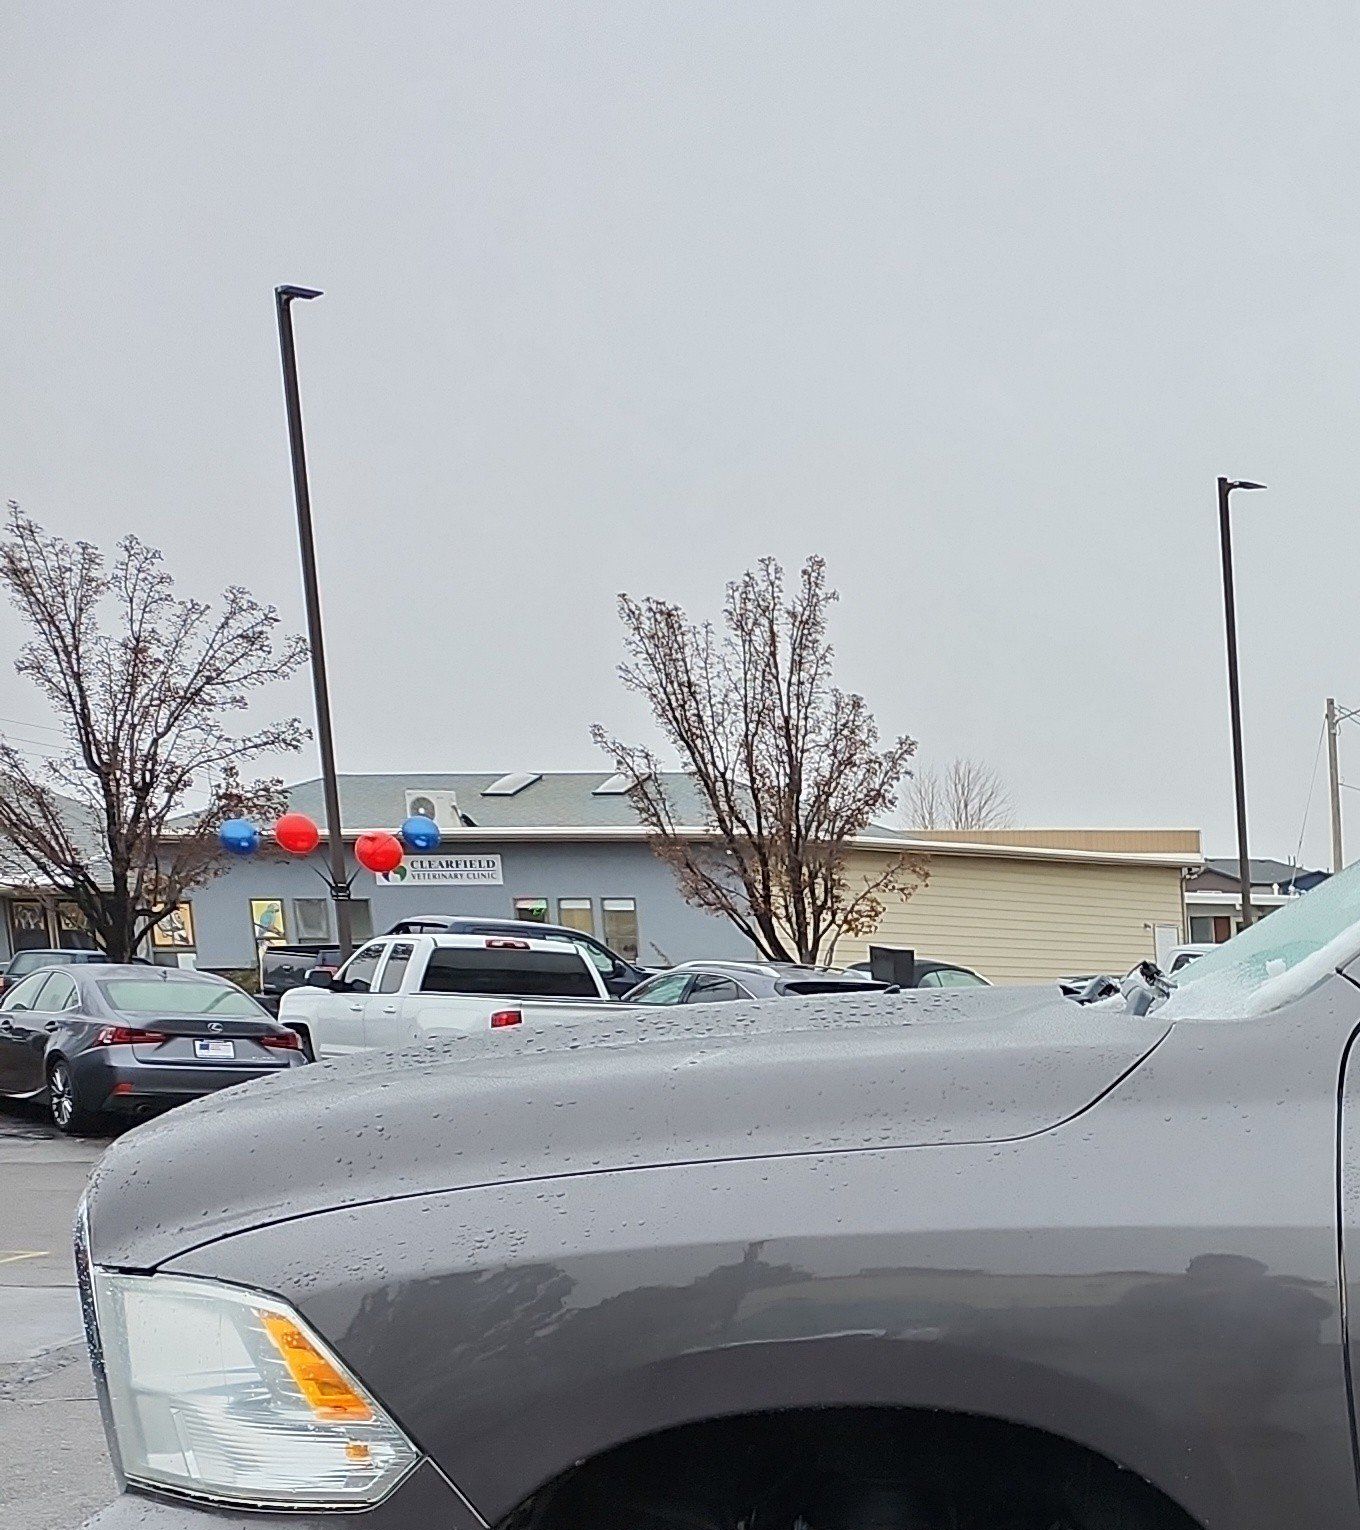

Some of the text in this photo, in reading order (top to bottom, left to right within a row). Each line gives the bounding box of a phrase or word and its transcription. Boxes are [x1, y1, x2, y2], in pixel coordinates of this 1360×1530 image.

[410, 859, 496, 869] CLEARFIELD
[411, 872, 497, 880] VETERINARY CLINIC
